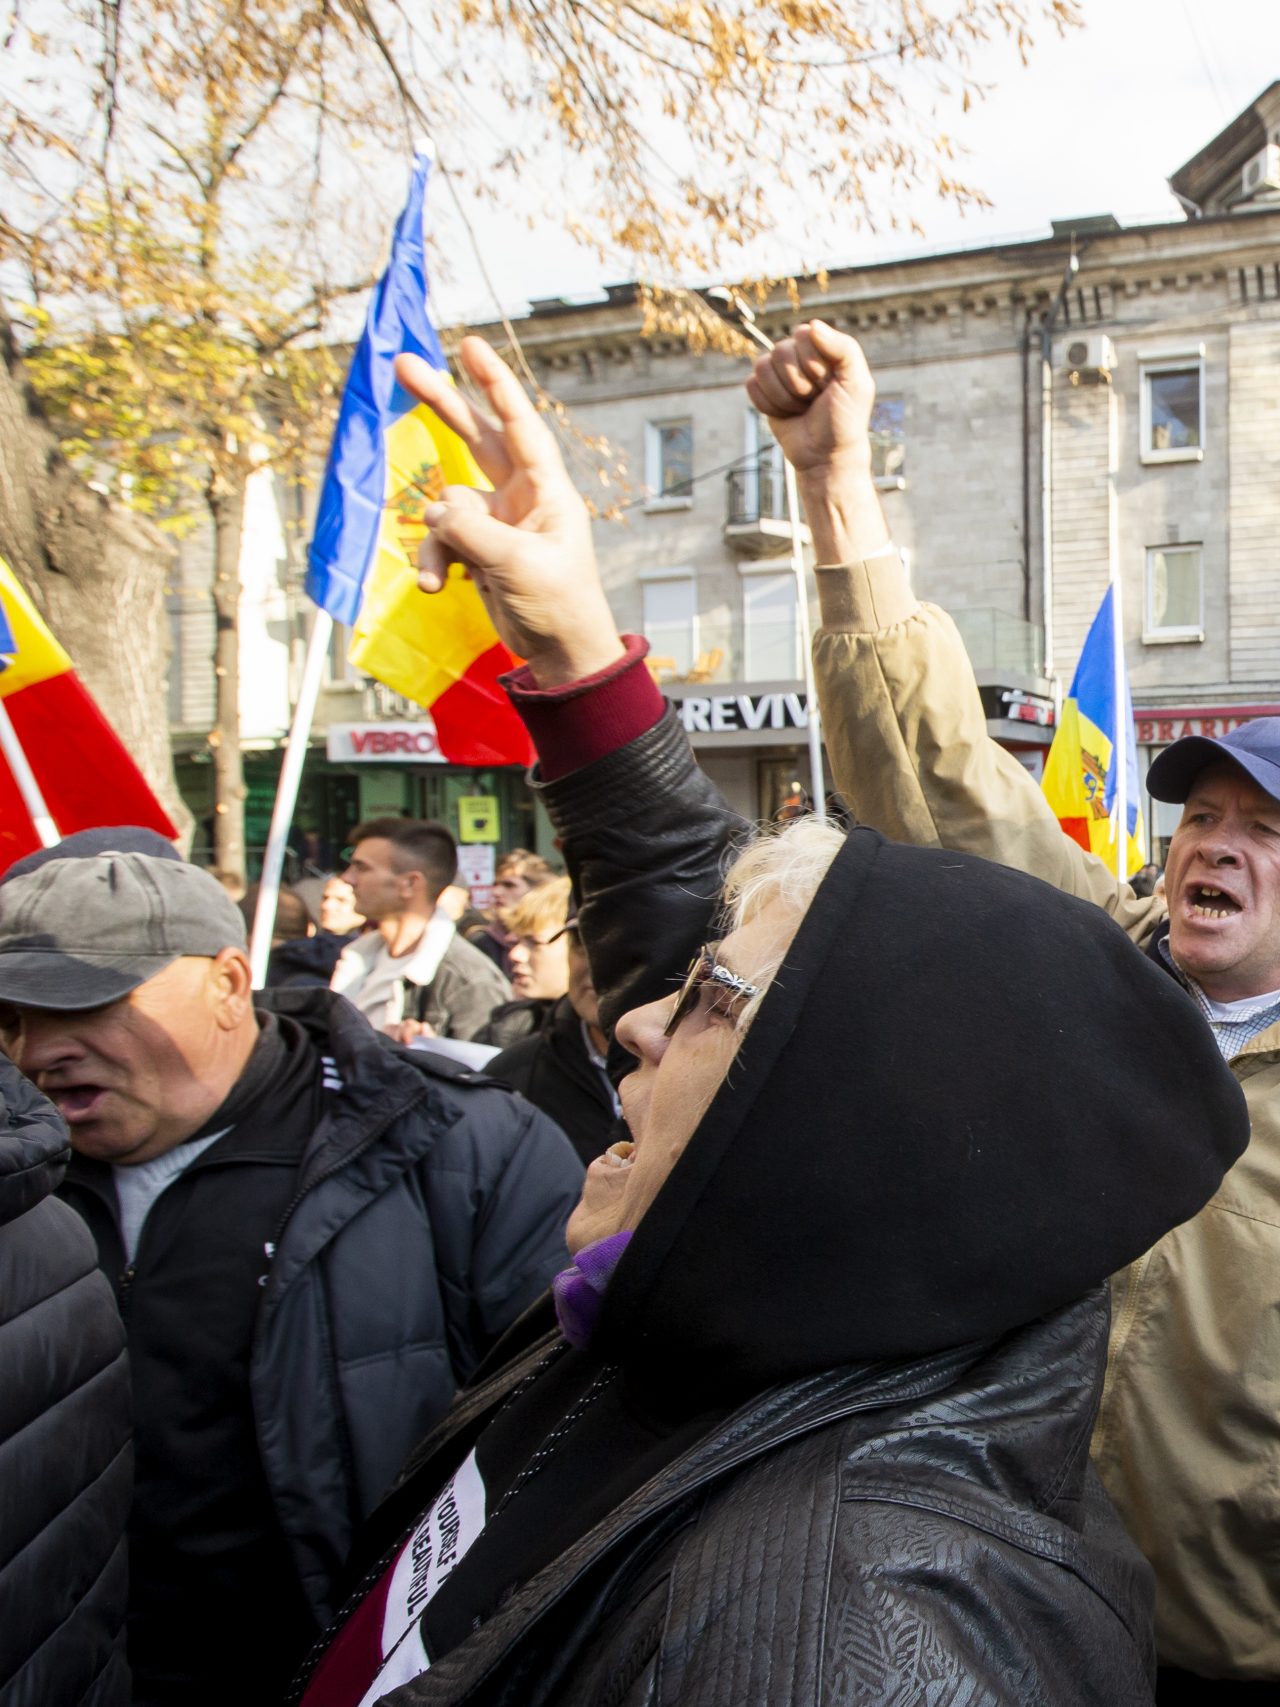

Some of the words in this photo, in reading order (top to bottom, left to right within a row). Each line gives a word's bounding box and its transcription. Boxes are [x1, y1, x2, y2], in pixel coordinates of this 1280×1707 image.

[677, 693, 808, 732] REVIV
[351, 731, 438, 754] VBRO
[437, 1491, 460, 1568] YOURSELF
[407, 1525, 433, 1616] BEAUTIFUL
